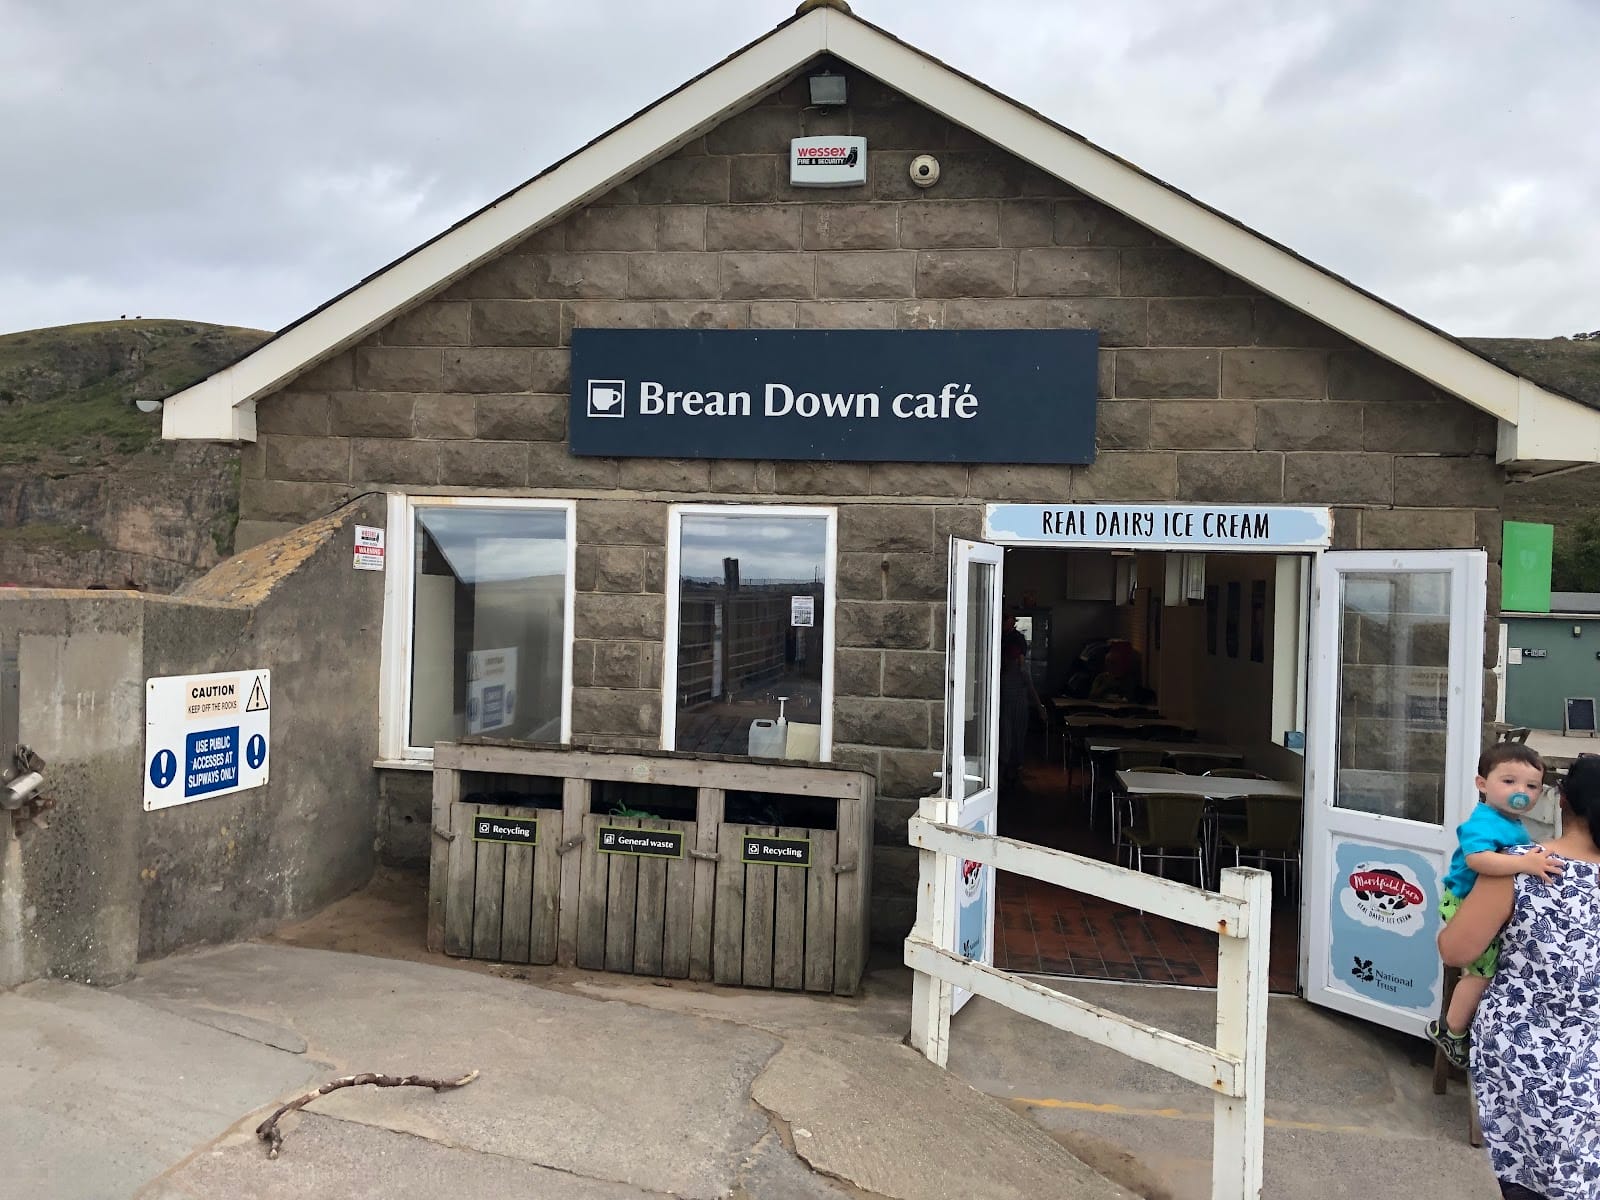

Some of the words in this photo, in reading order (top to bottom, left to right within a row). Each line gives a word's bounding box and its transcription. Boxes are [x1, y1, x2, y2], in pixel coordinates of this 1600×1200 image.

[797, 147, 846, 156] wessex
[639, 382, 751, 417] Brean
[764, 384, 880, 418] Down
[892, 383, 979, 419] café
[1042, 510, 1087, 536] REAL
[1096, 511, 1155, 538] DAIRY
[1163, 513, 1194, 538] ICE
[1202, 513, 1270, 540] CREAM
[191, 684, 235, 698] CAUTION
[188, 704, 200, 714] KEEP
[201, 703, 211, 712] OFF
[212, 702, 221, 711] THE
[221, 700, 237, 710] ROCKS
[195, 740, 208, 753] USE
[209, 736, 230, 751] PUBLIC
[192, 753, 224, 770] ACCESSES
[225, 752, 233, 764] AT
[188, 770, 219, 788] SLIPWAYS
[220, 767, 236, 781] ONLY
[493, 824, 530, 838] Recycling
[618, 836, 649, 847] General
[650, 840, 674, 849] waste
[763, 846, 803, 858] Recycling
[1400, 883, 1420, 901] Farm
[1375, 969, 1413, 988] National
[1376, 979, 1397, 992] Trust
